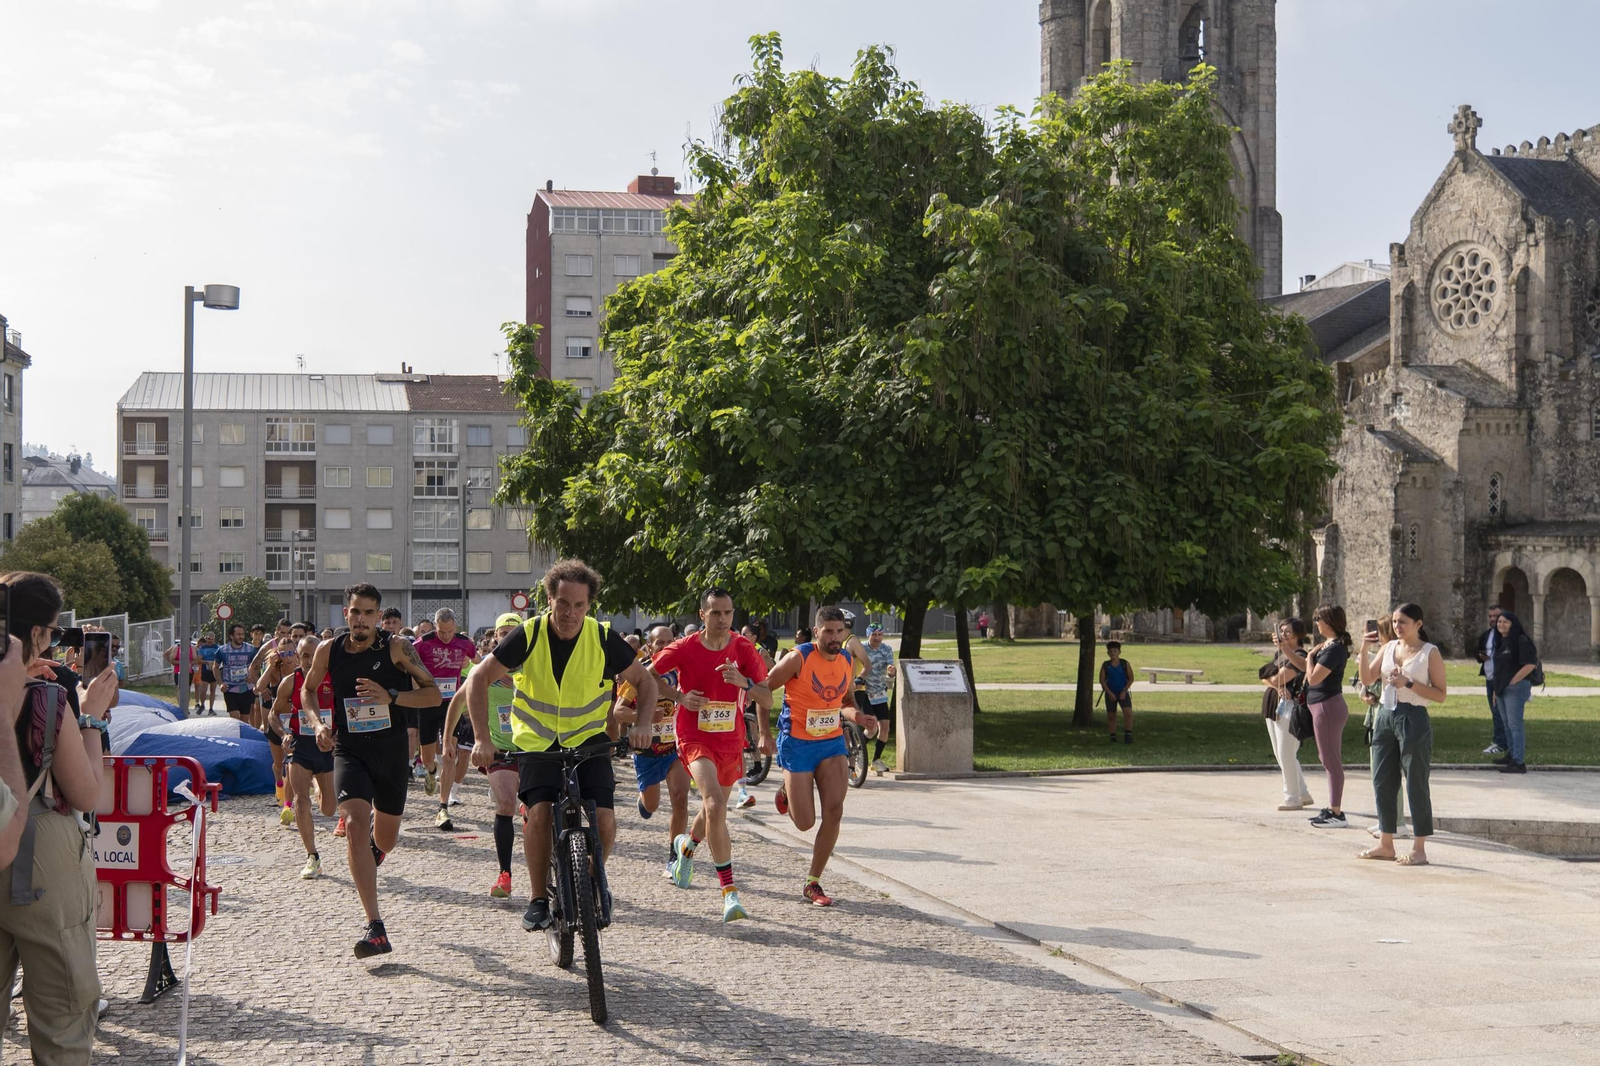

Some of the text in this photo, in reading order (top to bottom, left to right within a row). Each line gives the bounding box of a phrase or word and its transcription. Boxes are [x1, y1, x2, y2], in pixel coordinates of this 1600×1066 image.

[369, 707, 376, 716] 5
[714, 710, 731, 719] 363
[819, 716, 835, 724] 326
[104, 851, 136, 863] LOCAL
